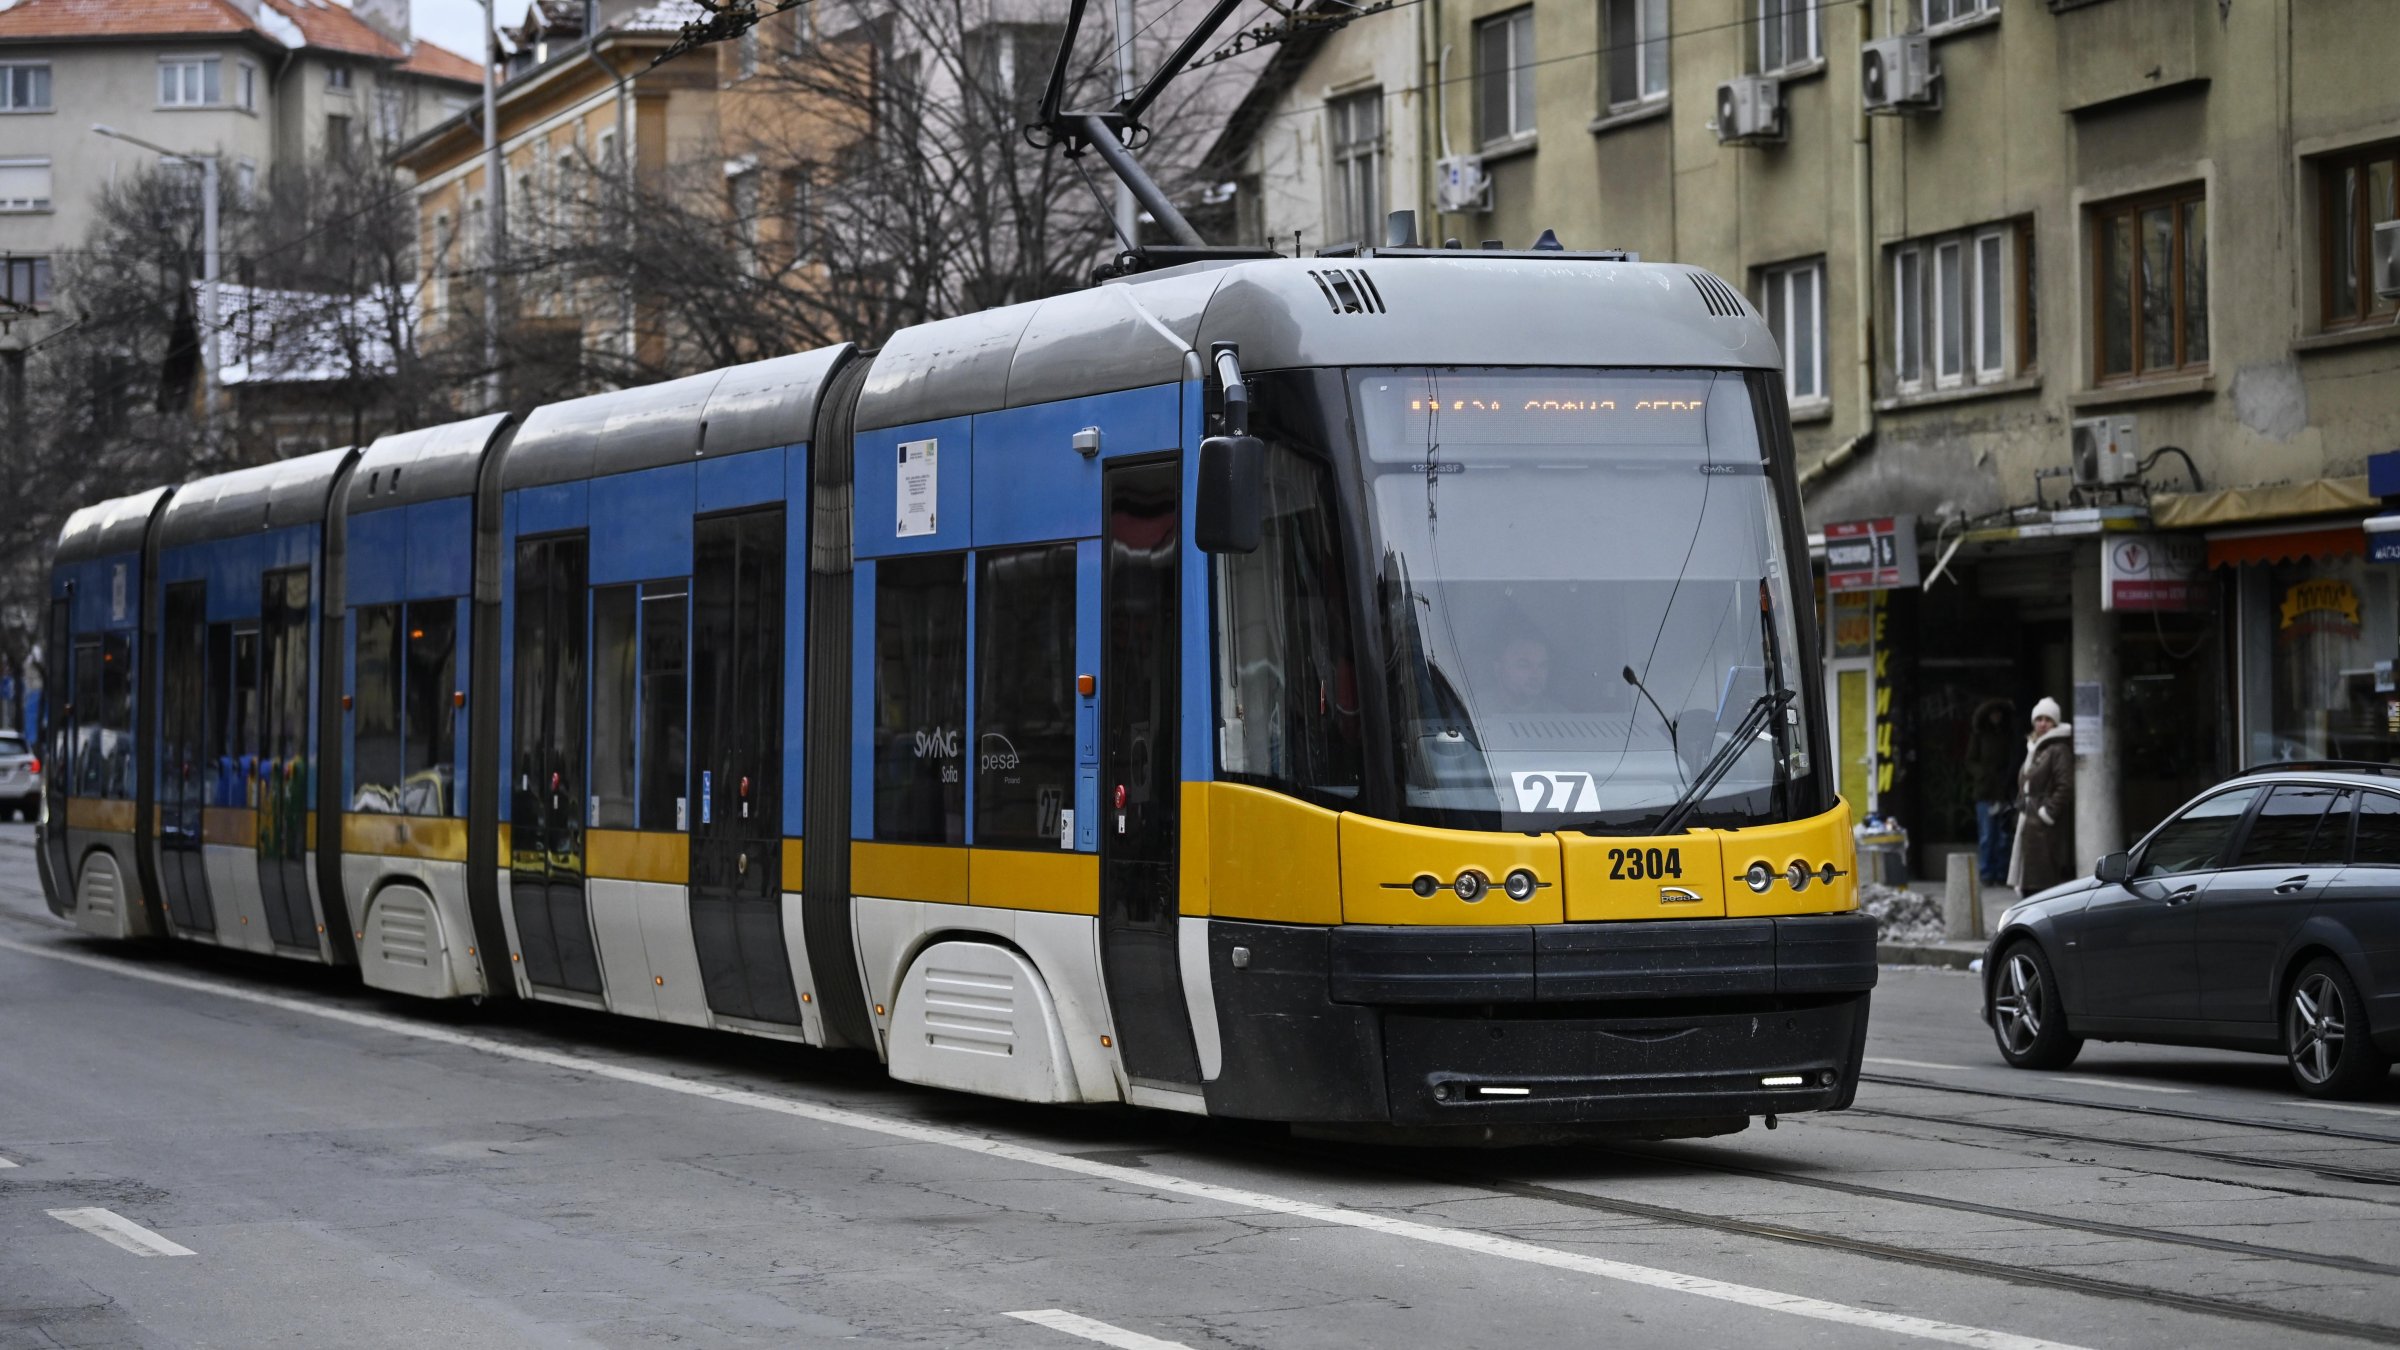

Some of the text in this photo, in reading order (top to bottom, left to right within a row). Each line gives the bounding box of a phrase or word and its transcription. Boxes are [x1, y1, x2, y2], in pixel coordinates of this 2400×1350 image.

[941, 765, 958, 783] Sofia
[981, 753, 1015, 775] pesa
[1522, 774, 1588, 813] 27
[1040, 789, 1061, 835] 27
[1607, 847, 1683, 880] 2304
